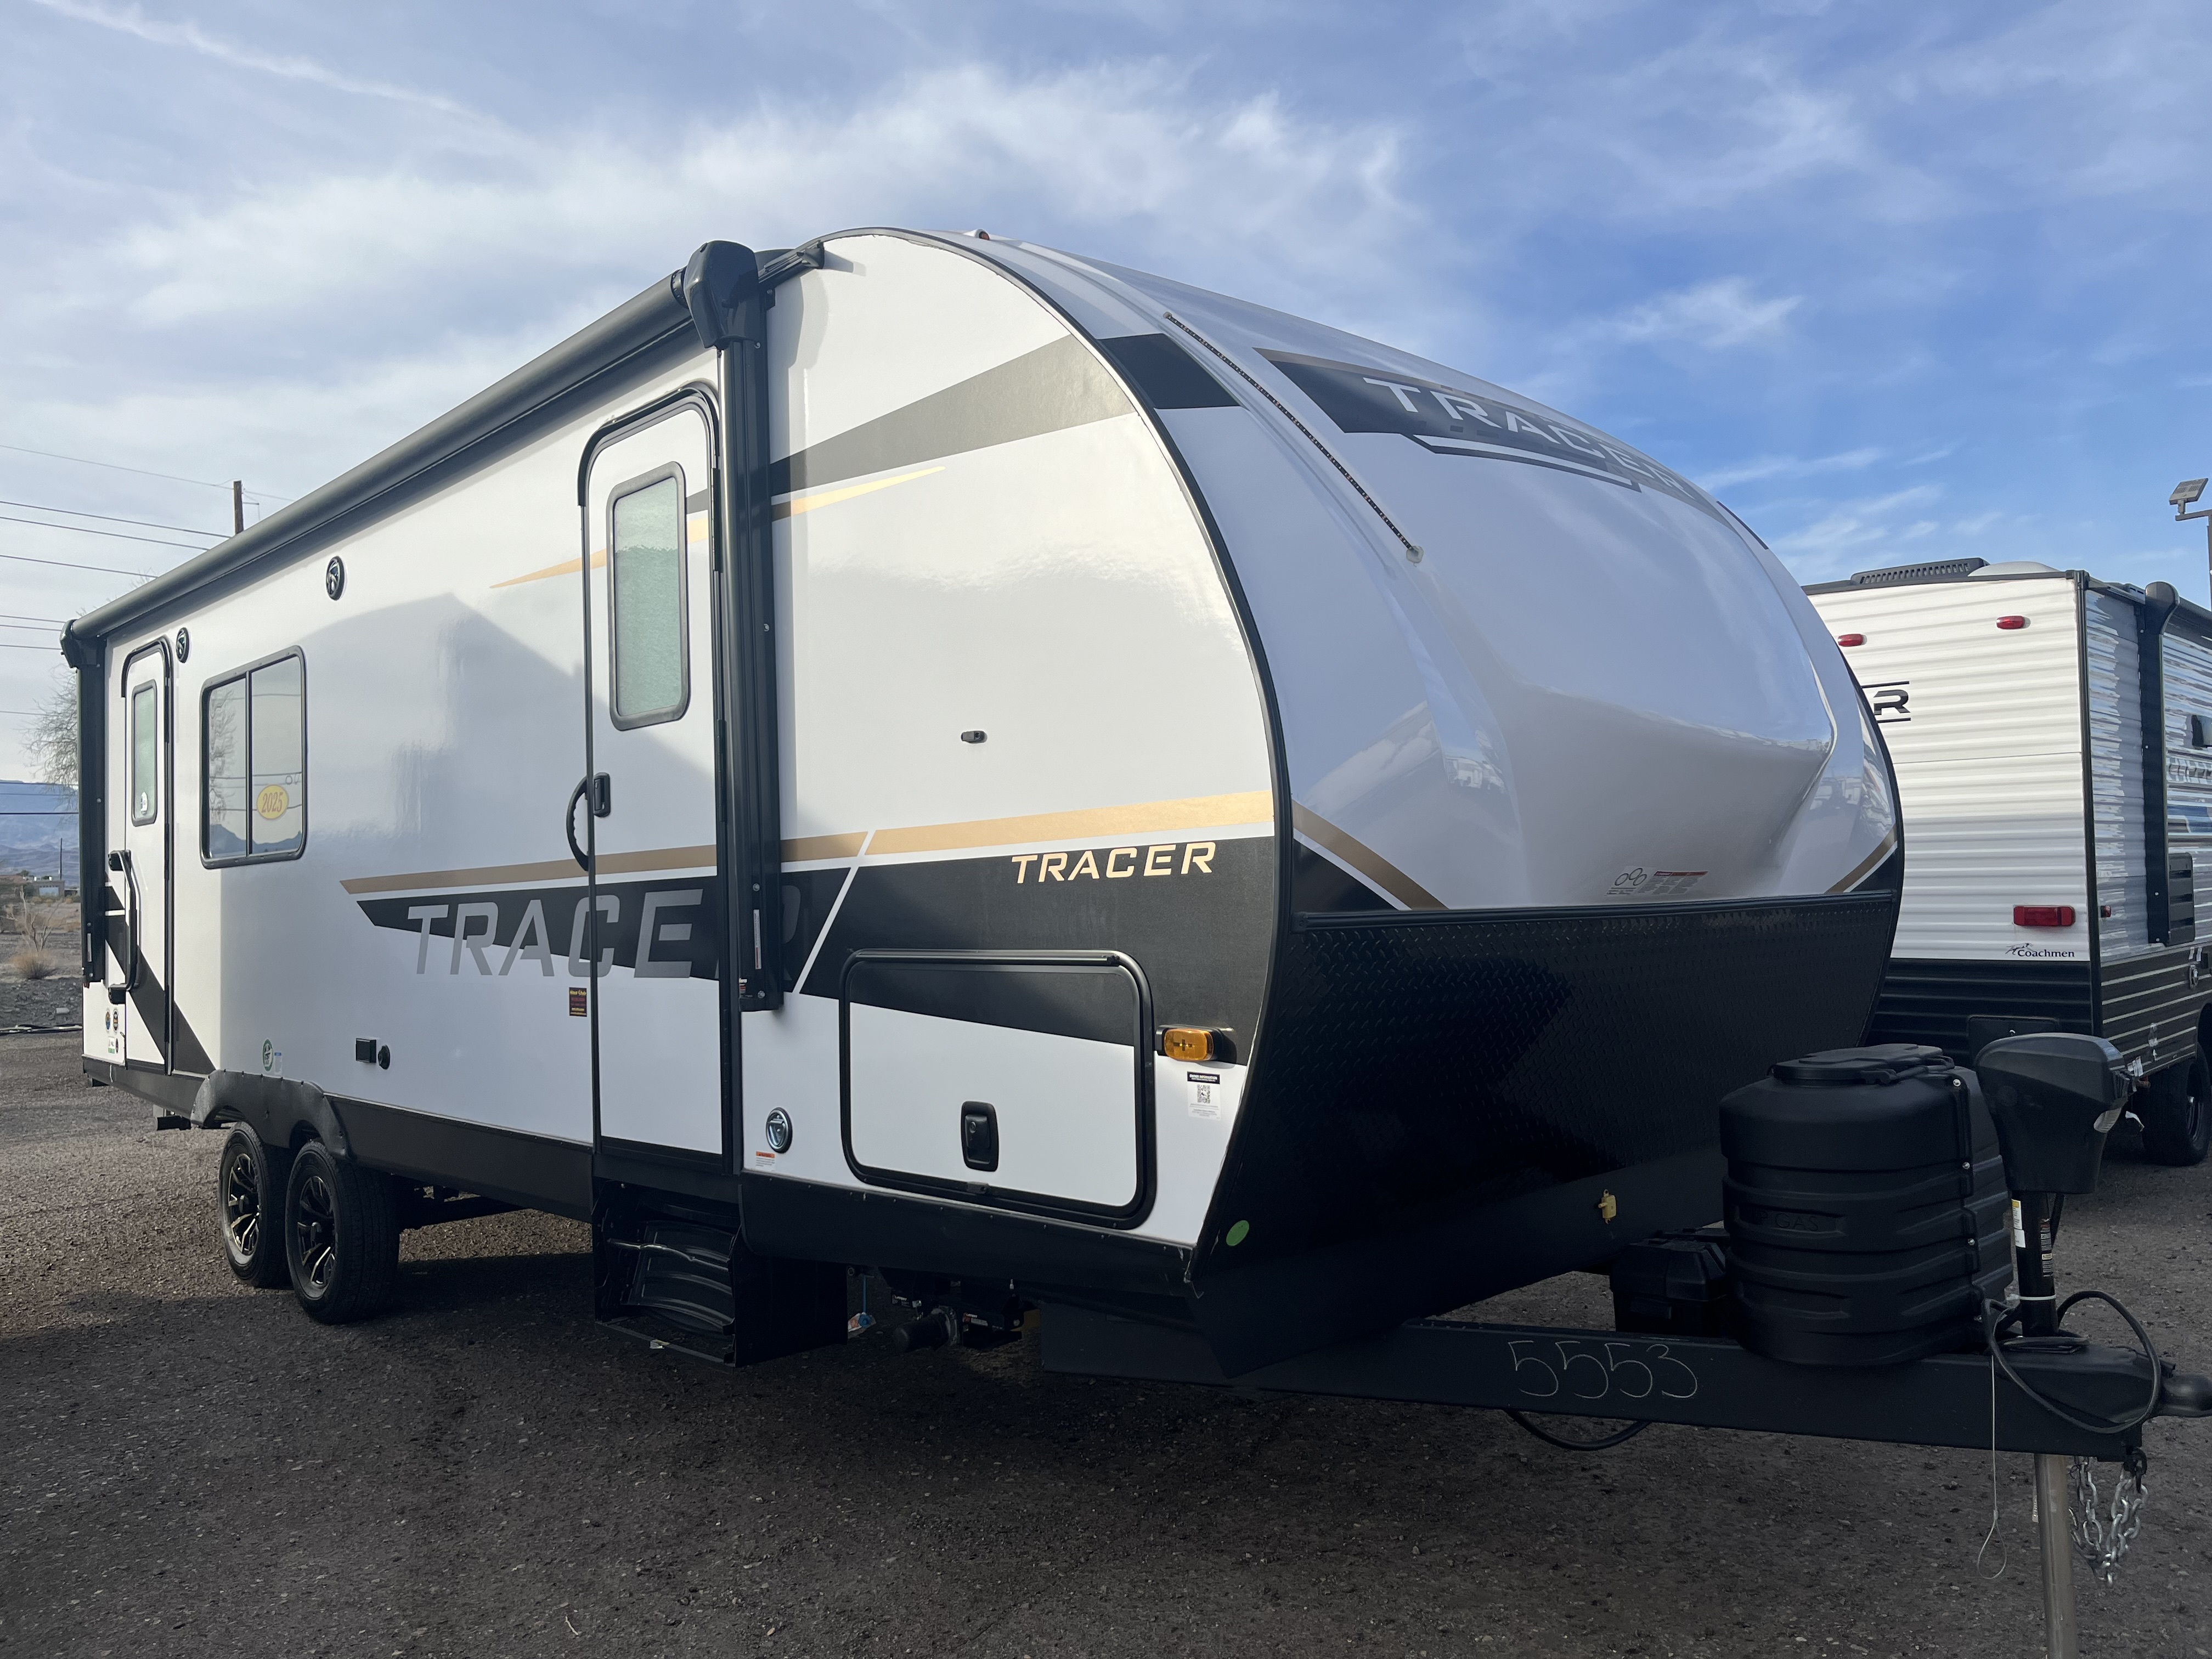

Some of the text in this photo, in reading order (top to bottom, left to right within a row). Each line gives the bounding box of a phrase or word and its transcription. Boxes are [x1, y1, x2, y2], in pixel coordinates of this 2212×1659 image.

[1363, 376, 1697, 499] TRACER
[261, 792, 284, 813] 2025
[1011, 841, 1216, 884] TRACER
[2017, 949, 2075, 957] Coachmen
[1775, 1212, 1819, 1232] GAS
[1508, 1340, 1698, 1399] 5553
